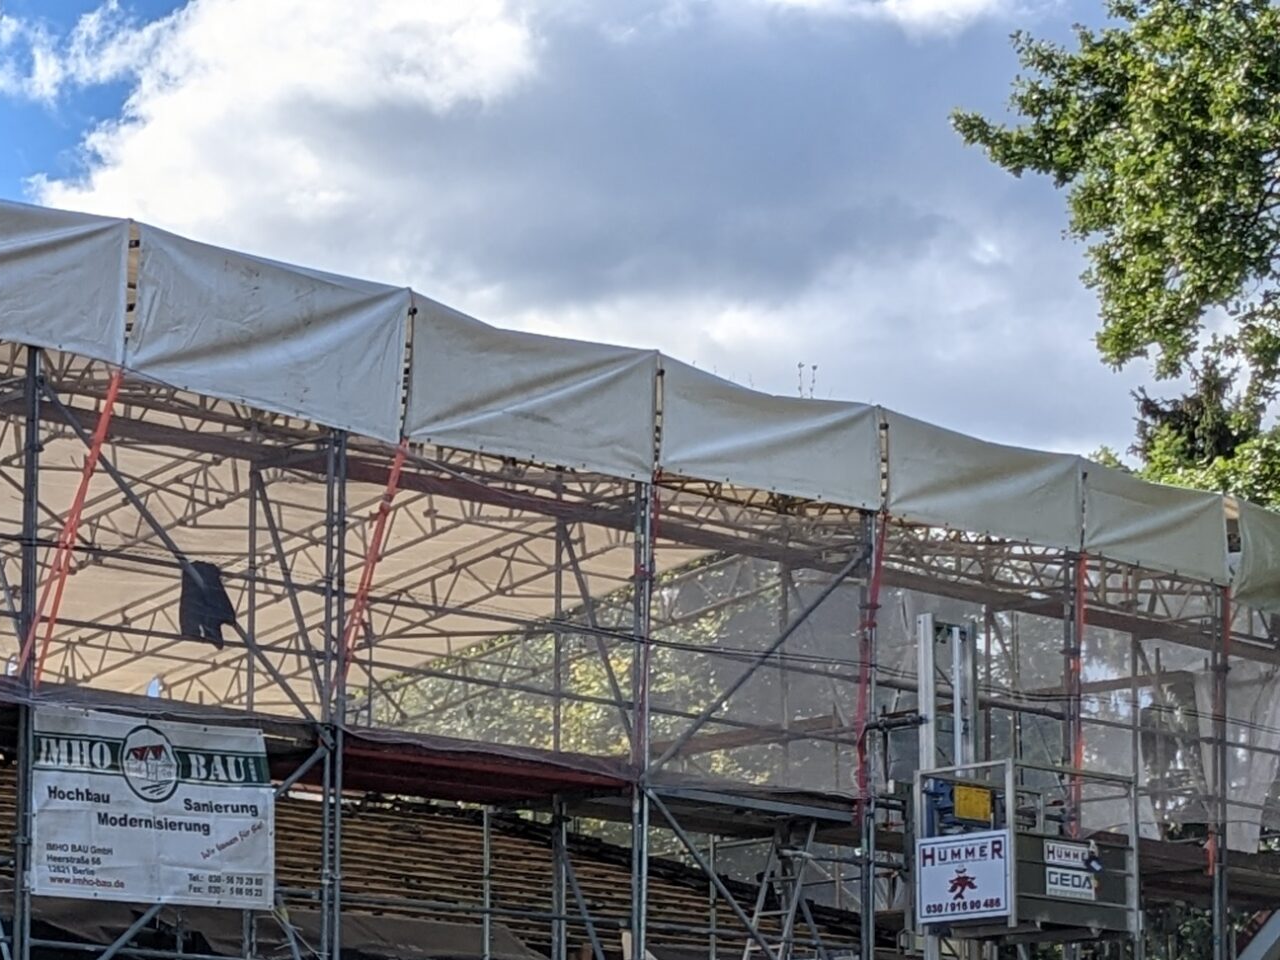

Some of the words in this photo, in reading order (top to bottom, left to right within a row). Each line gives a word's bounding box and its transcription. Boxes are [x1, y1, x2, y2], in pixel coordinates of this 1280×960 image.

[38, 737, 112, 769] IMHO
[187, 753, 245, 782] BAU
[47, 785, 110, 804] Hochbau
[184, 798, 259, 817] Sanierung
[97, 812, 211, 836] Modernisierung
[71, 844, 89, 853] BAU
[922, 840, 1004, 867] HUMMER
[1046, 844, 1089, 861] HUMME
[1048, 871, 1093, 889] GEDA
[926, 902, 943, 914] 030
